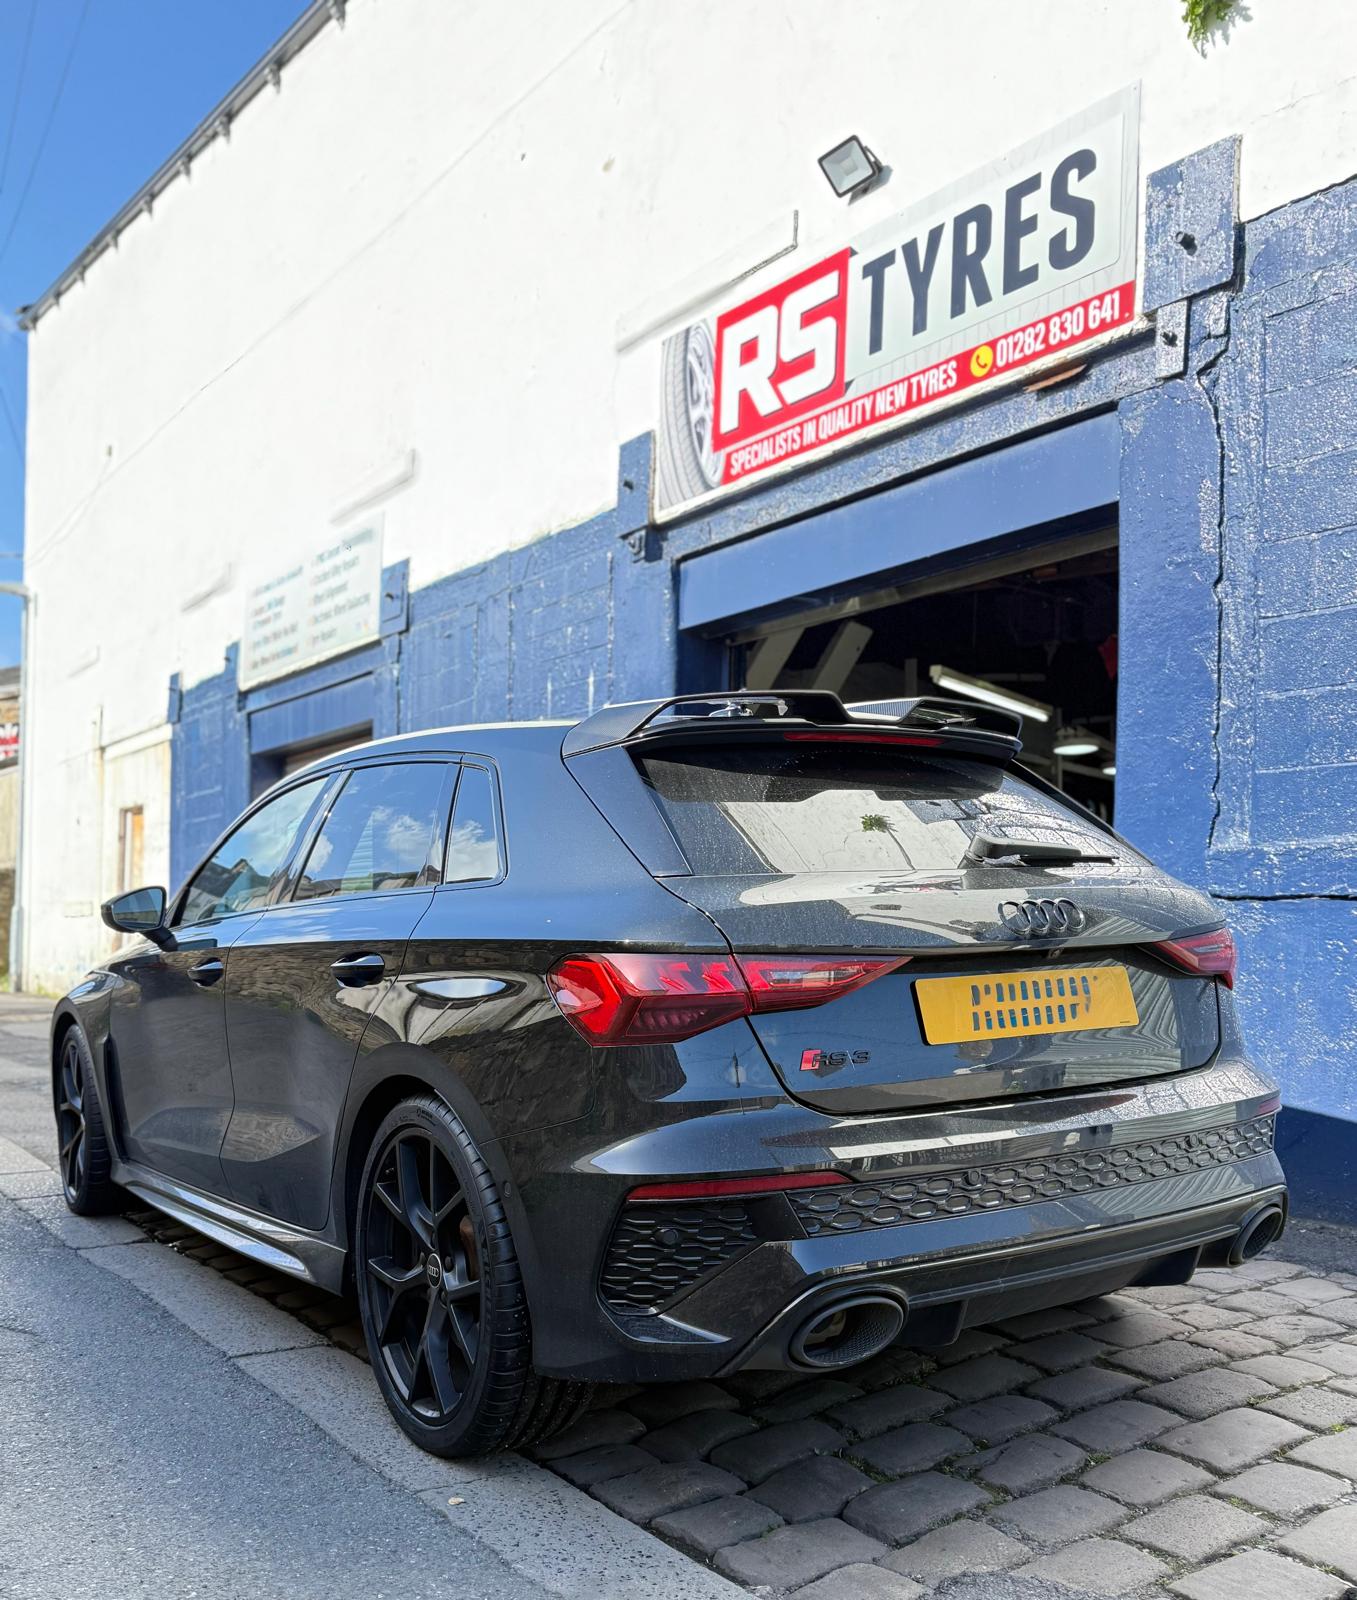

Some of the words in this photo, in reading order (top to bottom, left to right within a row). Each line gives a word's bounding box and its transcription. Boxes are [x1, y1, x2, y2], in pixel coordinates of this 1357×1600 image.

[719, 270, 840, 435] RS
[861, 148, 1097, 356] TYRES
[995, 322, 1046, 367] 01282
[1049, 307, 1085, 346] 830
[1088, 290, 1121, 330] 641
[730, 427, 801, 477] SPECIALISTS
[802, 419, 817, 447] IN
[818, 395, 874, 440] QUALITY
[875, 378, 908, 416] NEW
[910, 362, 958, 402] TYRES
